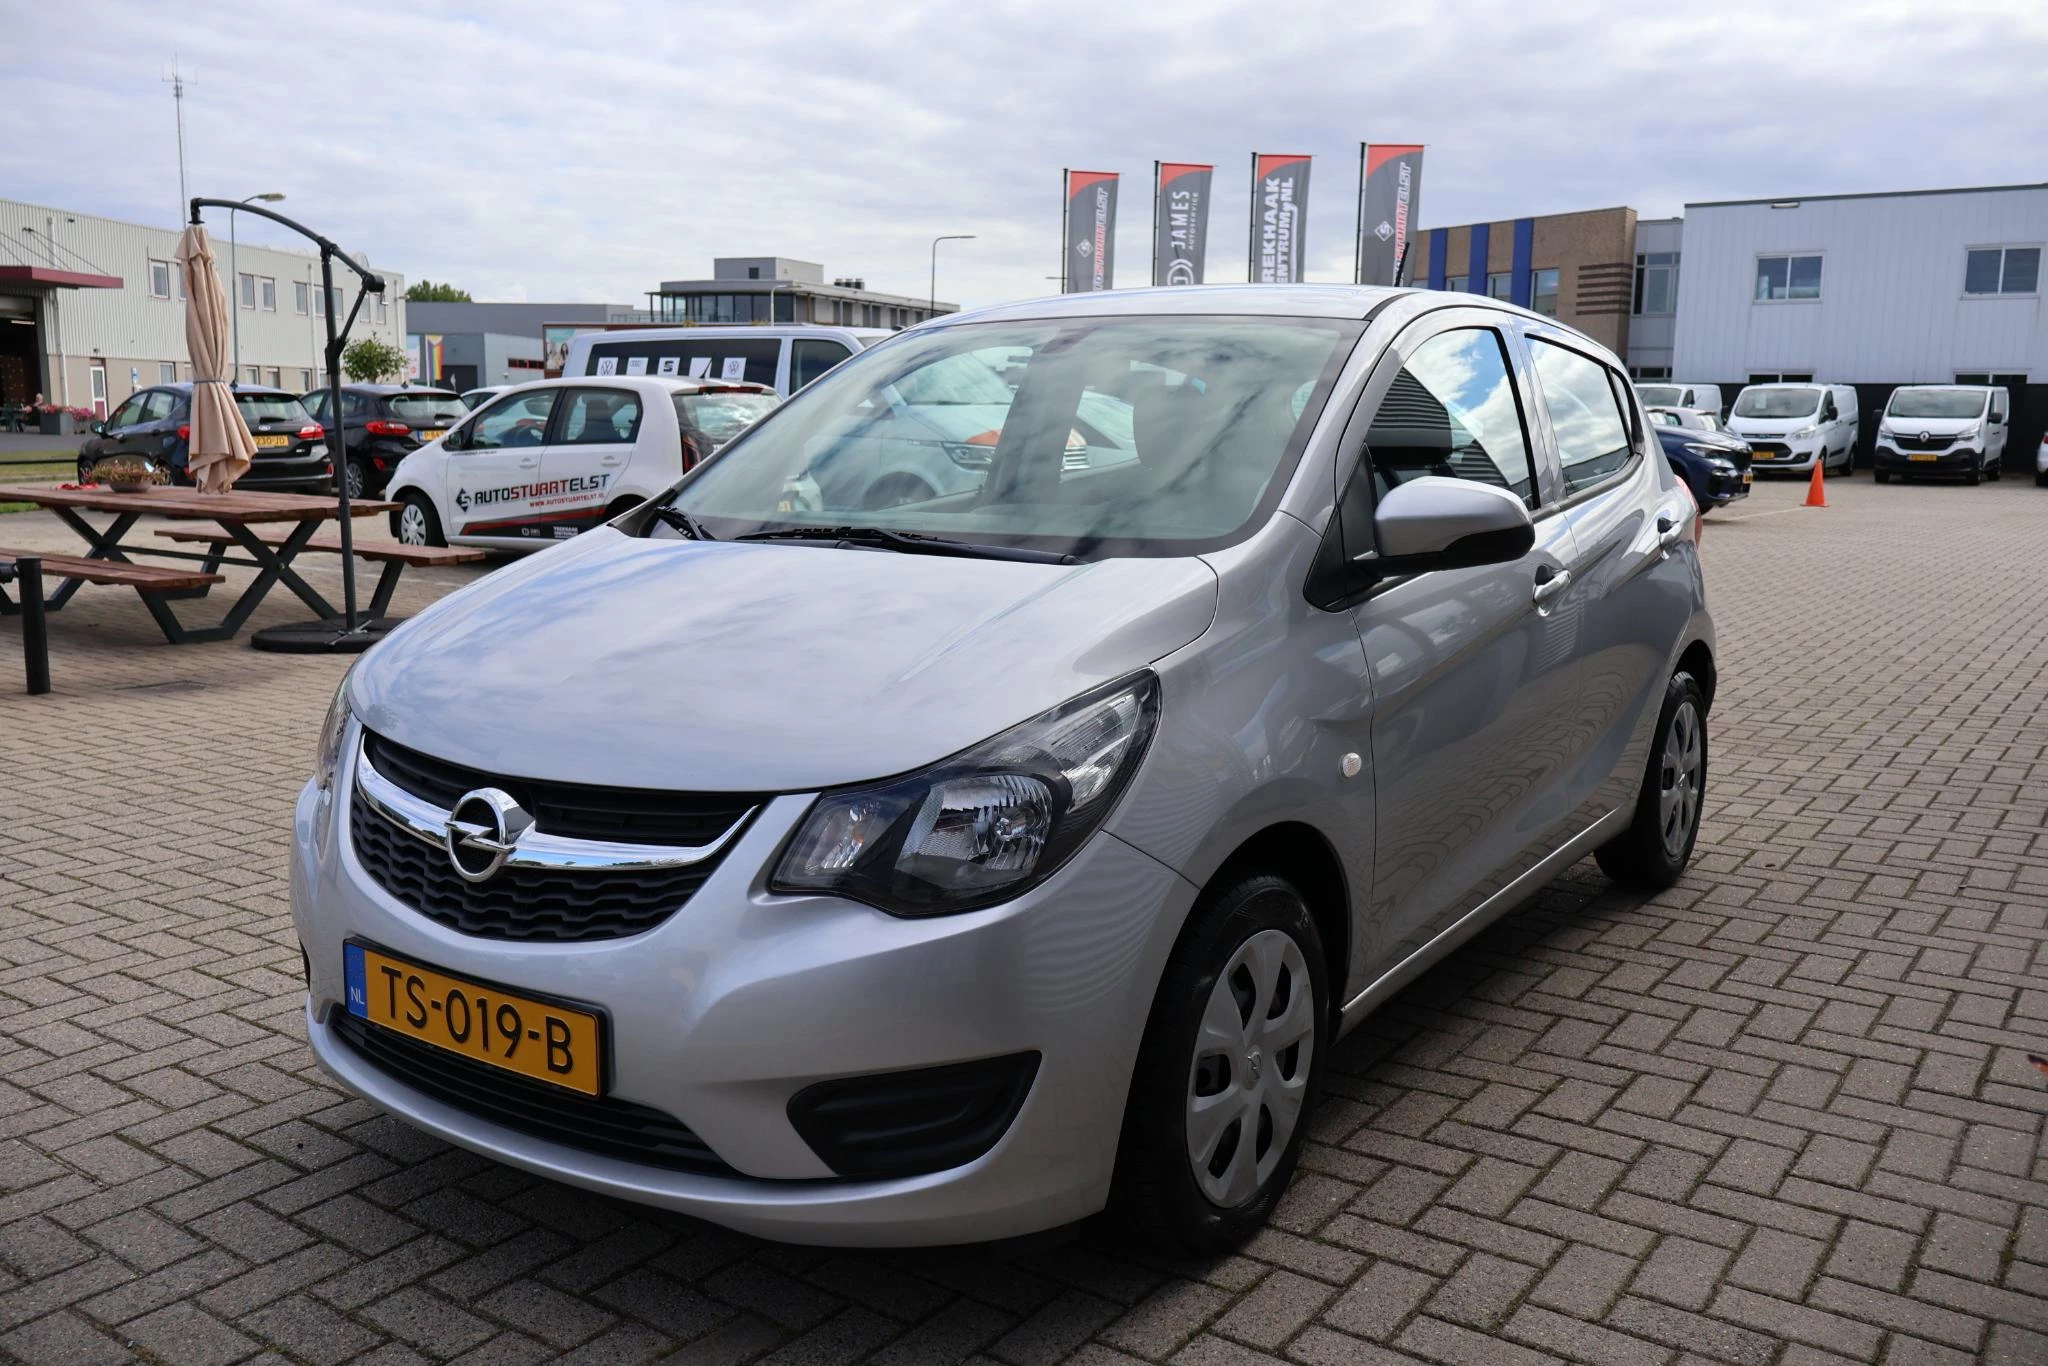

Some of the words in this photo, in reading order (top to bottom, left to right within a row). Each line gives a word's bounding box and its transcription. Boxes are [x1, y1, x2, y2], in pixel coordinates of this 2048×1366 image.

[1170, 190, 1190, 250] JAMES
[1188, 191, 1200, 251] AUTOSERVICE
[474, 473, 610, 505] AUTOSTUARTELST
[350, 986, 365, 1006] NL
[381, 965, 574, 1075] TS-019-B
